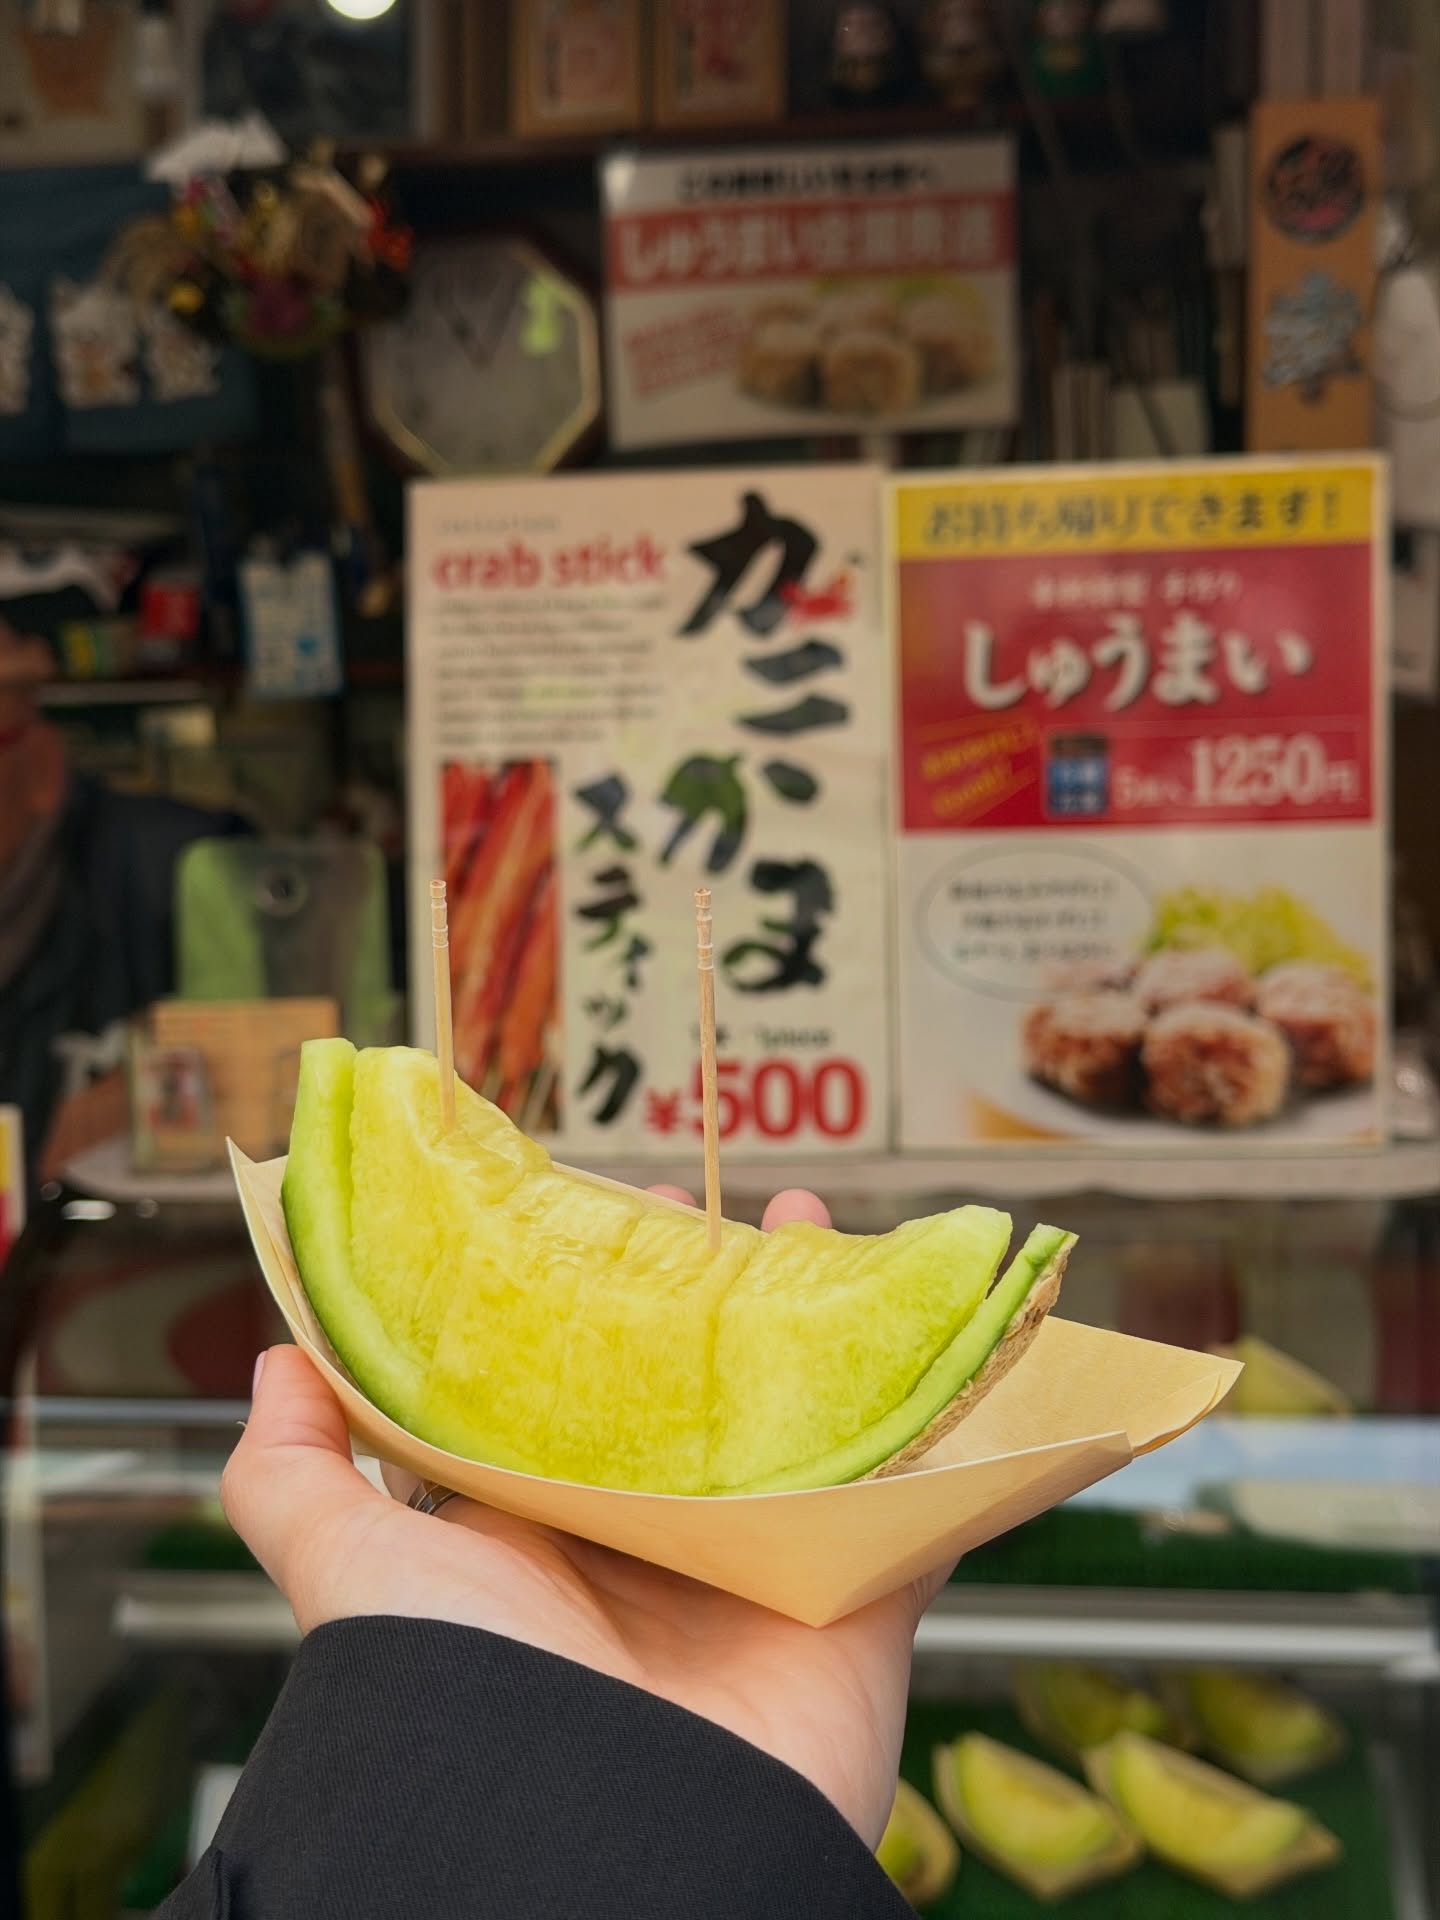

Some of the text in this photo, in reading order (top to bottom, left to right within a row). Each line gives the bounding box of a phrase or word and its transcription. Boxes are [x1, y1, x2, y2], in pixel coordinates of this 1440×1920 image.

[434, 533, 666, 590] crab stick
[963, 609, 1314, 711] しゅうまい
[573, 772, 653, 1126] スティック
[644, 1056, 867, 1144] ¥500
